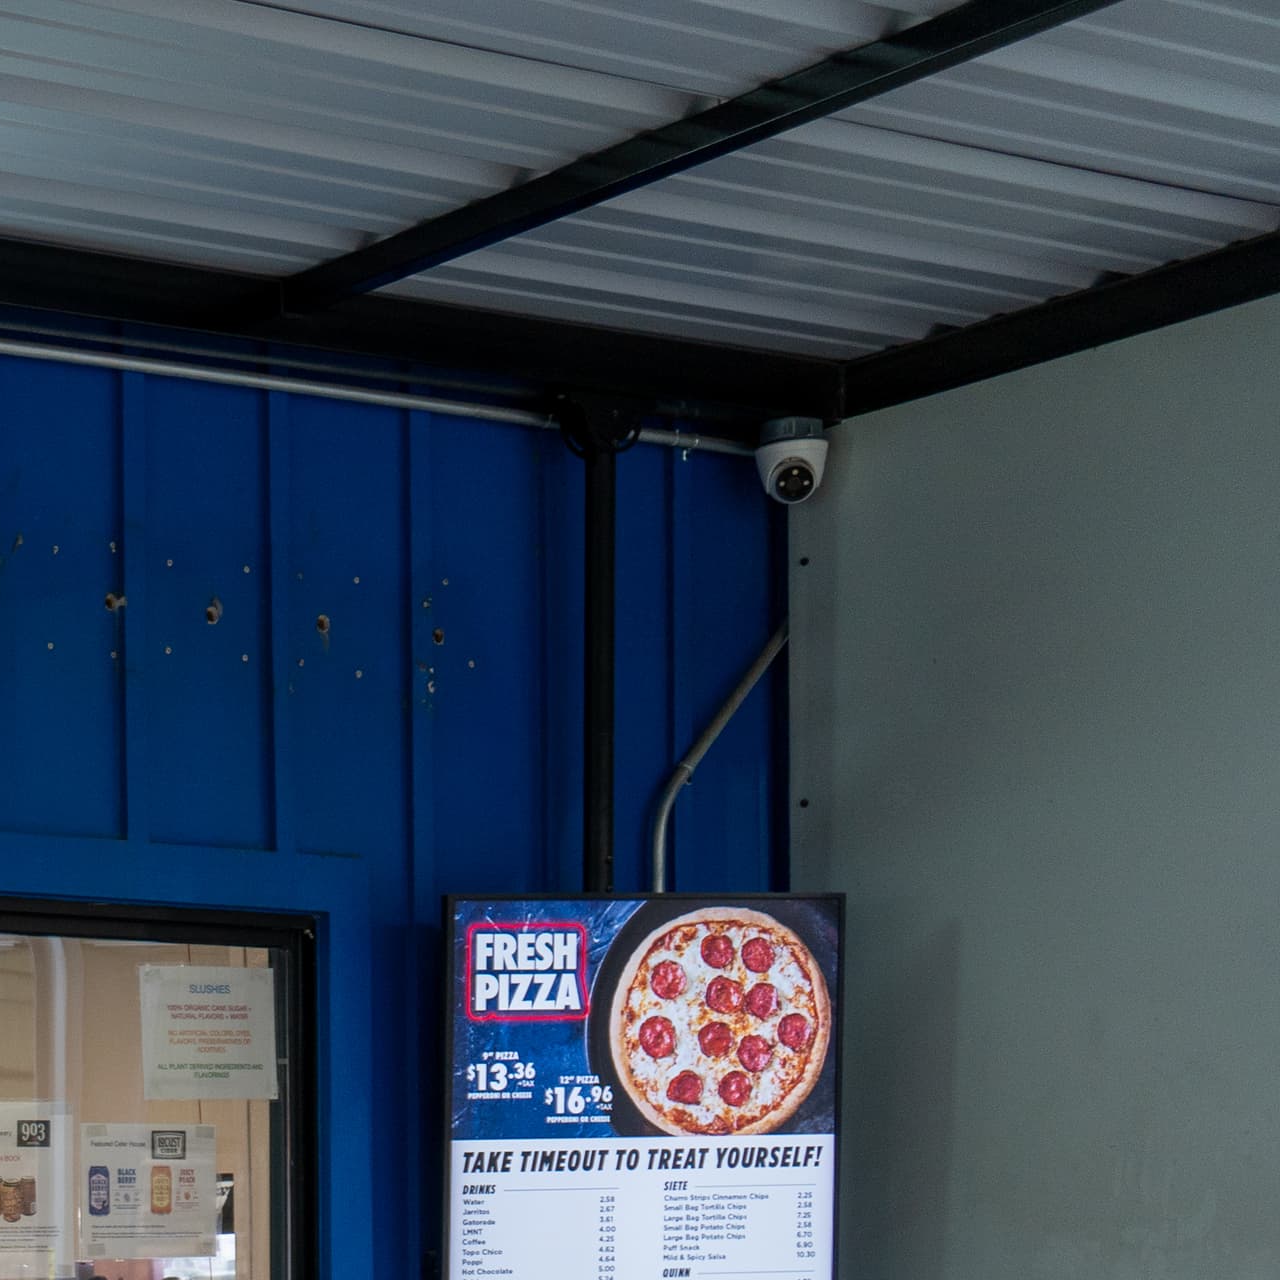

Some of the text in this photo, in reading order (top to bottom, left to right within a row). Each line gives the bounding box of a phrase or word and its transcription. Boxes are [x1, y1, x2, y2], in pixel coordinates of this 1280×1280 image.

[476, 933, 577, 971] FRESH
[190, 985, 231, 994] SLUSHIES
[475, 974, 580, 1010] PIZZA
[467, 1063, 535, 1091] $13.36
[545, 1086, 613, 1114] $16.96
[463, 1146, 822, 1173] TAKE TIMEOUT TO TREAT YOURSELF!
[463, 1185, 496, 1195] DRINKS
[664, 1181, 688, 1191] SIETE
[663, 1268, 690, 1277] QUINN
